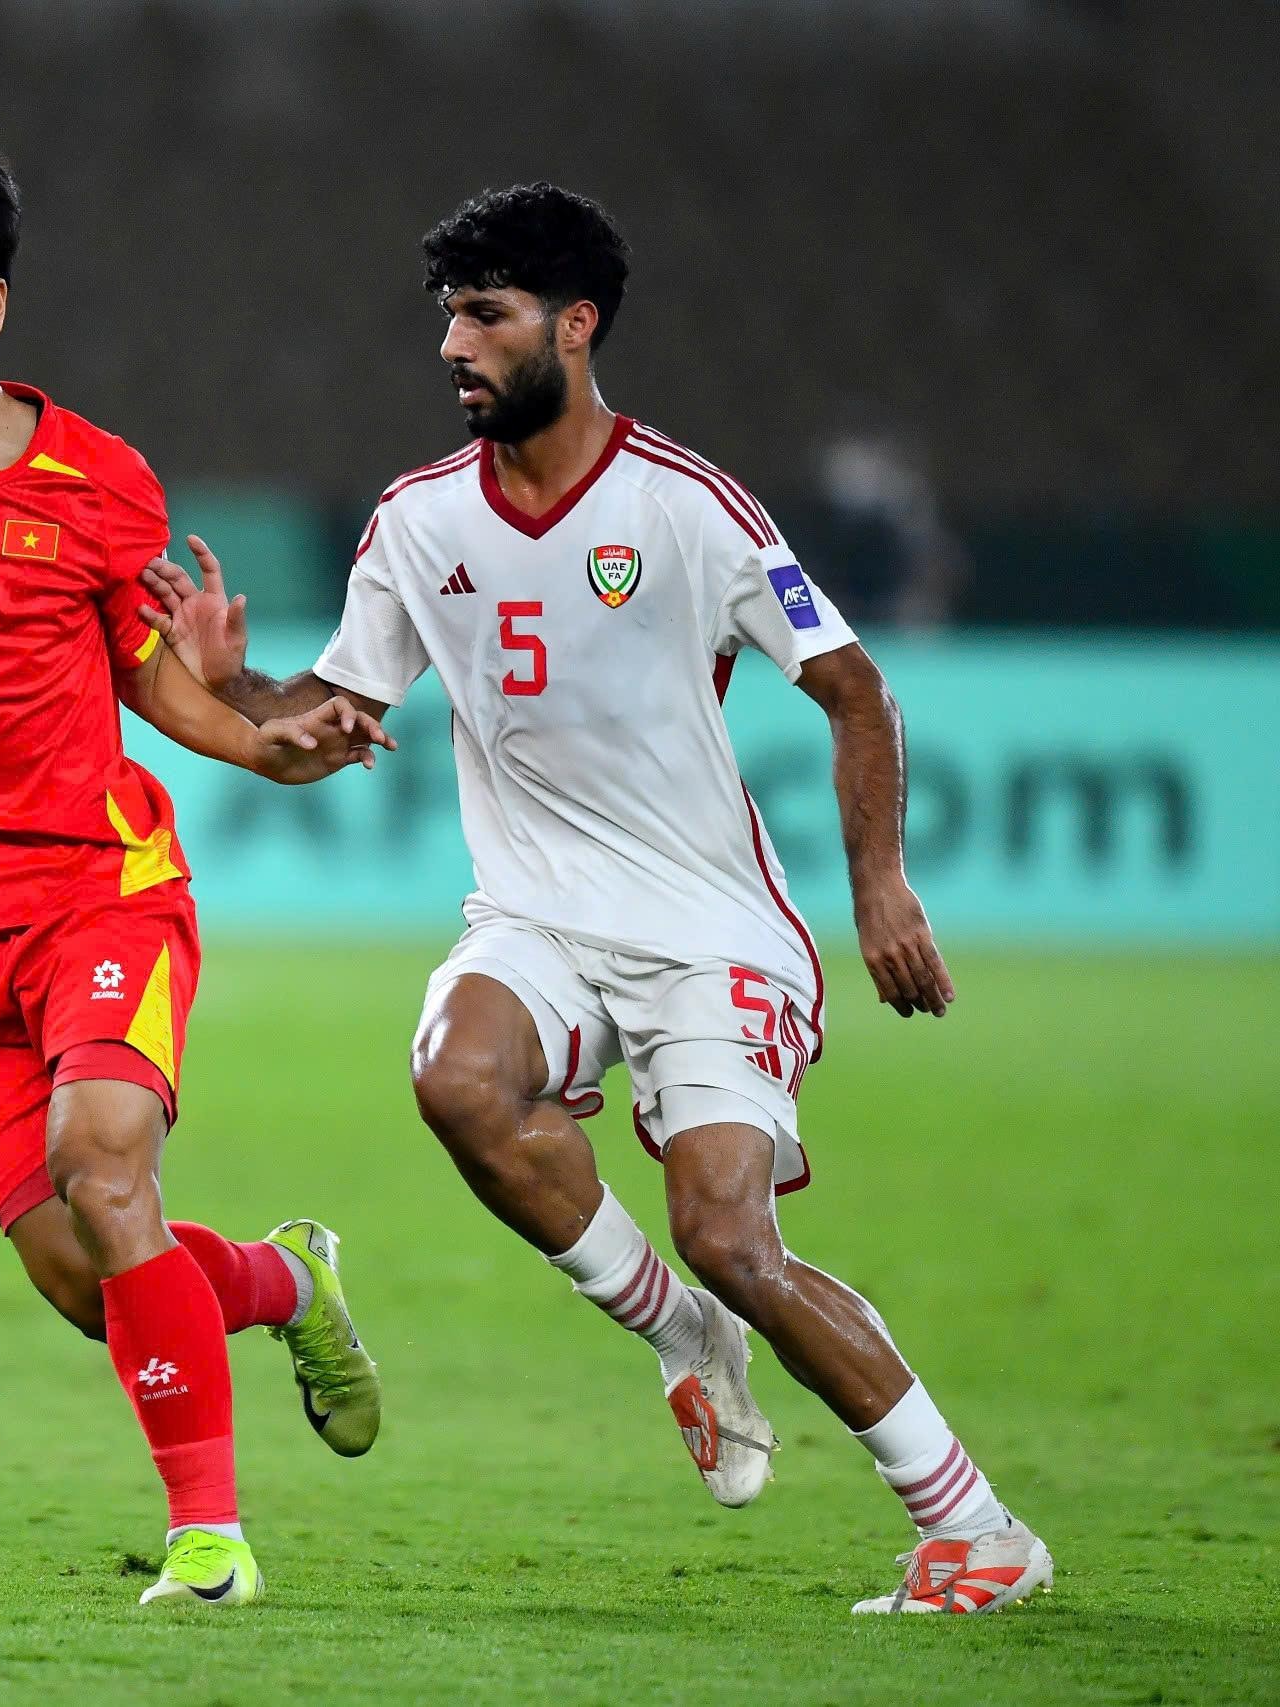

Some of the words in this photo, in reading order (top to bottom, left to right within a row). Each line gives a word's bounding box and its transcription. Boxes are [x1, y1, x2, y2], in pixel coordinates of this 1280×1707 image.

[602, 562, 627, 571] UAE
[608, 572, 622, 580] FA
[783, 584, 810, 606] AFC
[497, 601, 548, 697] 5
[728, 965, 777, 1042] 5
